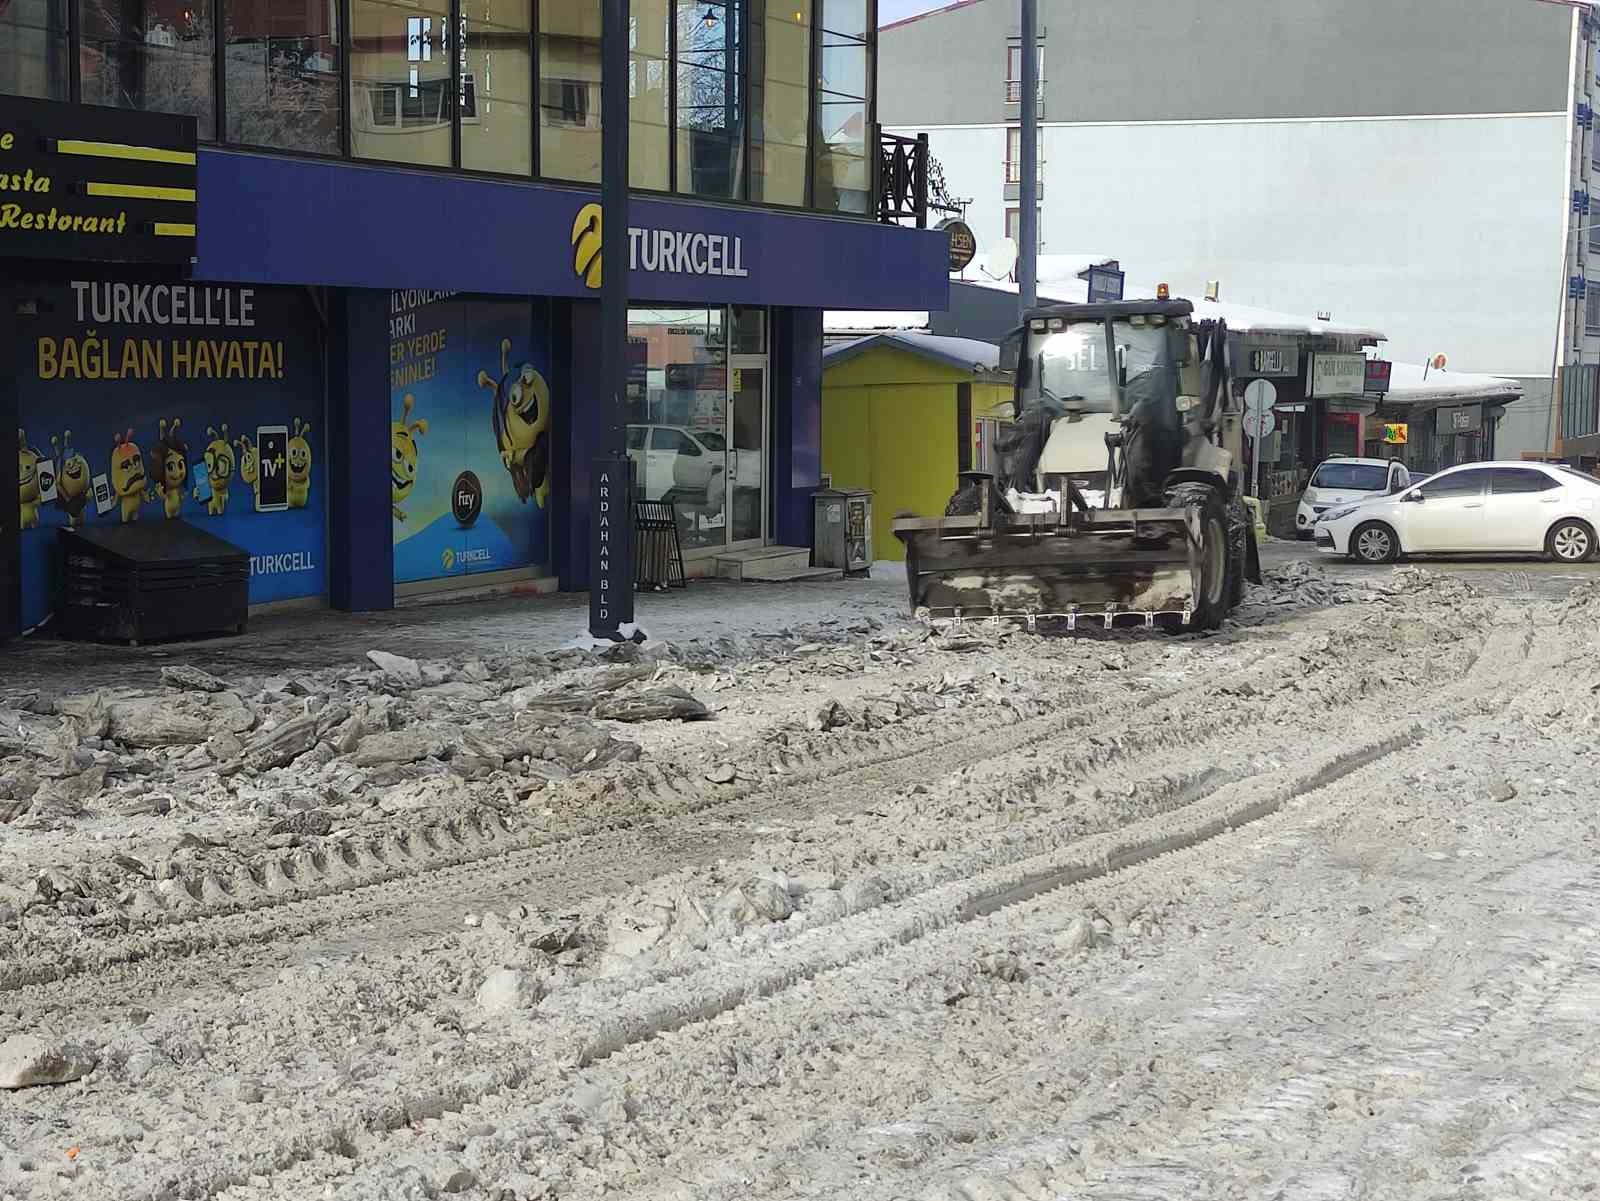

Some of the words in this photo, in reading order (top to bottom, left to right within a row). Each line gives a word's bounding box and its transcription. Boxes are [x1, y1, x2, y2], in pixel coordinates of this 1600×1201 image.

[0, 202, 127, 234] Restorant
[627, 226, 748, 278] TURKCELL
[70, 280, 255, 327] TURKCELL'LE
[37, 328, 163, 380] BAĞLAN
[172, 340, 285, 379] HAYATA!
[407, 328, 446, 360] YERDE
[600, 472, 609, 571] ARDAHAN
[249, 551, 315, 577] TURKCELL
[456, 547, 491, 563] TURKCELL
[600, 579, 609, 619] BLD
